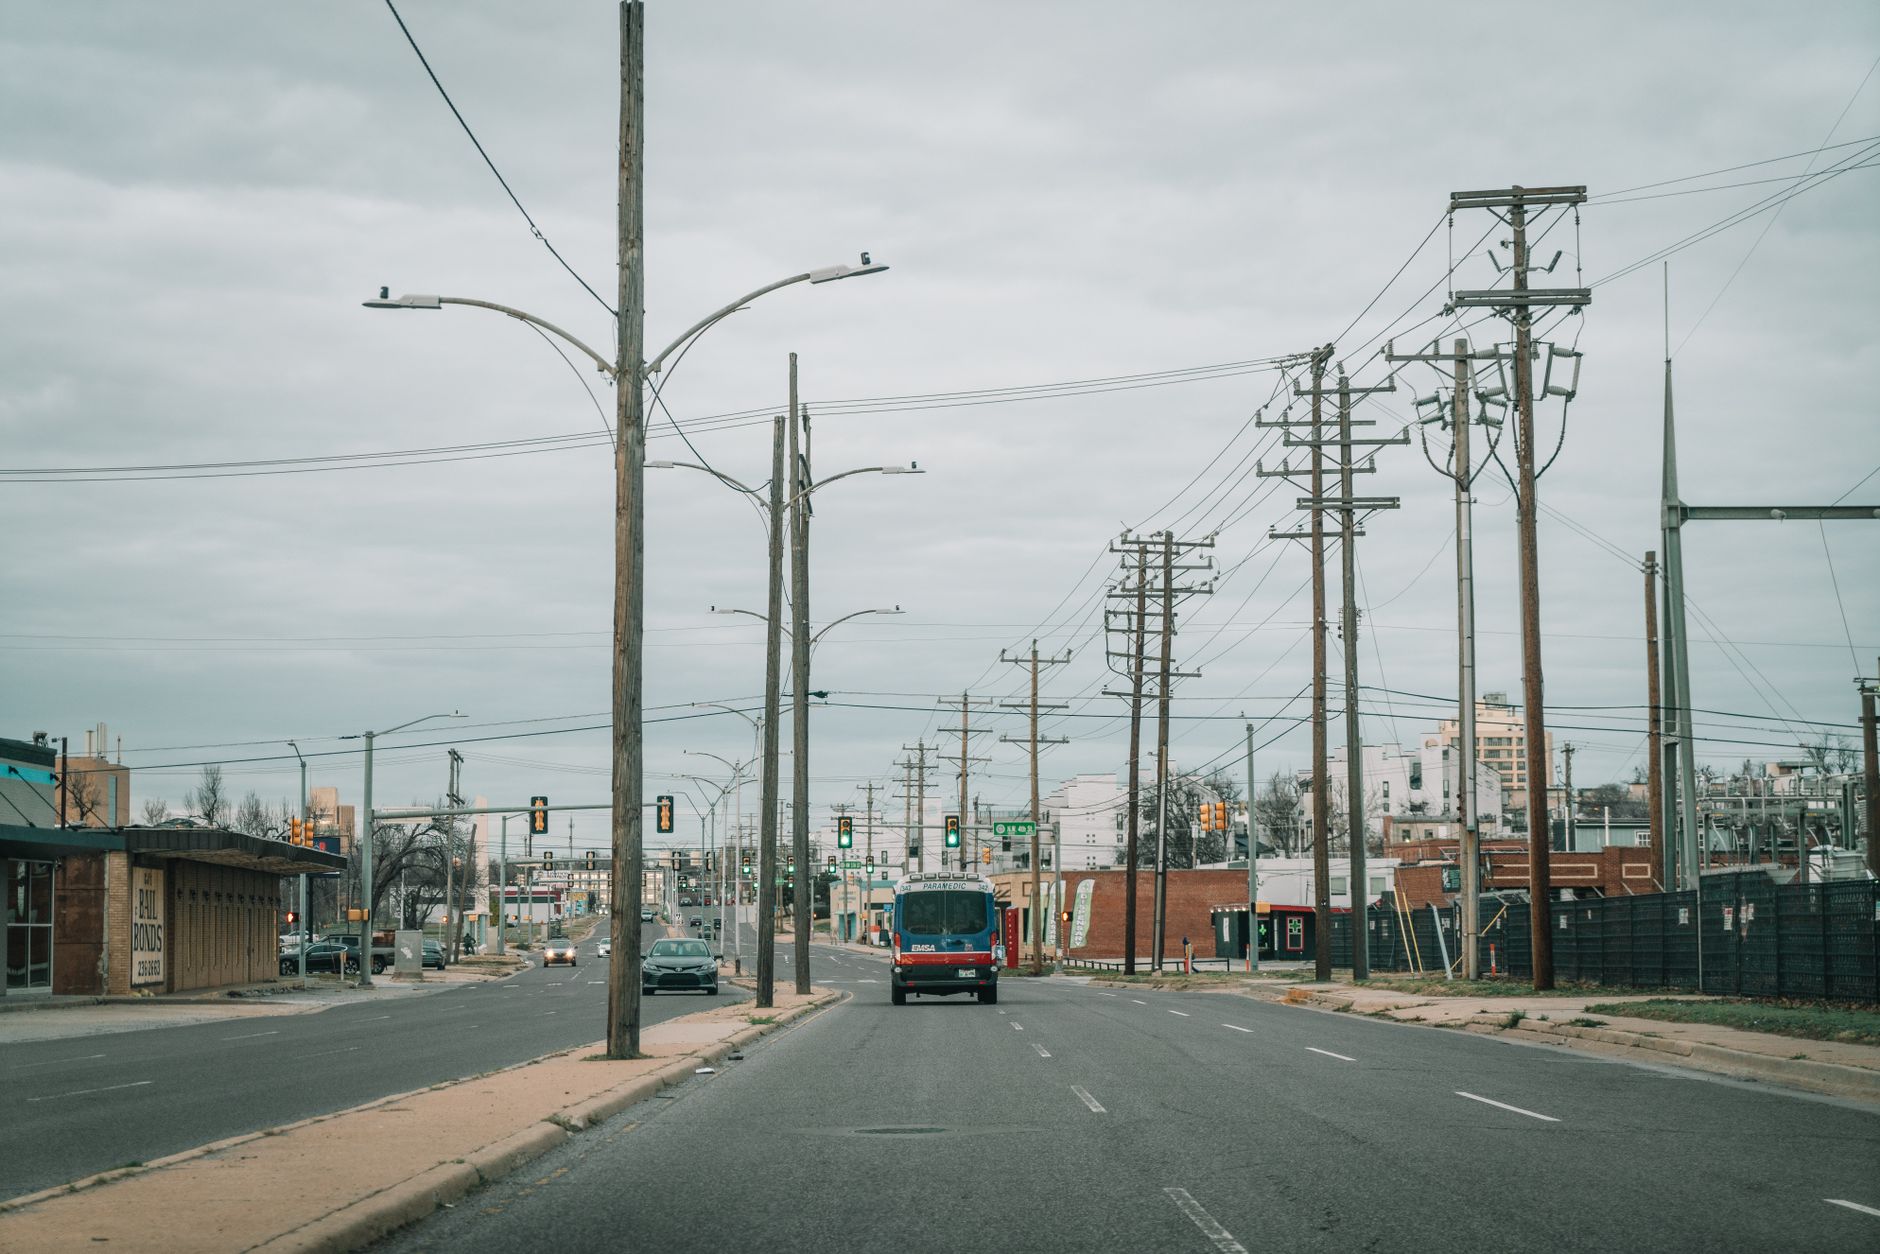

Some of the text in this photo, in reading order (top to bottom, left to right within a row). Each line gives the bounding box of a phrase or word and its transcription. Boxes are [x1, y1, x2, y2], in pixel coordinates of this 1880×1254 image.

[922, 882, 967, 890] PARAMEDIC
[139, 888, 157, 920] BAIL
[133, 922, 162, 952] BONDS
[911, 944, 936, 952] EMSA
